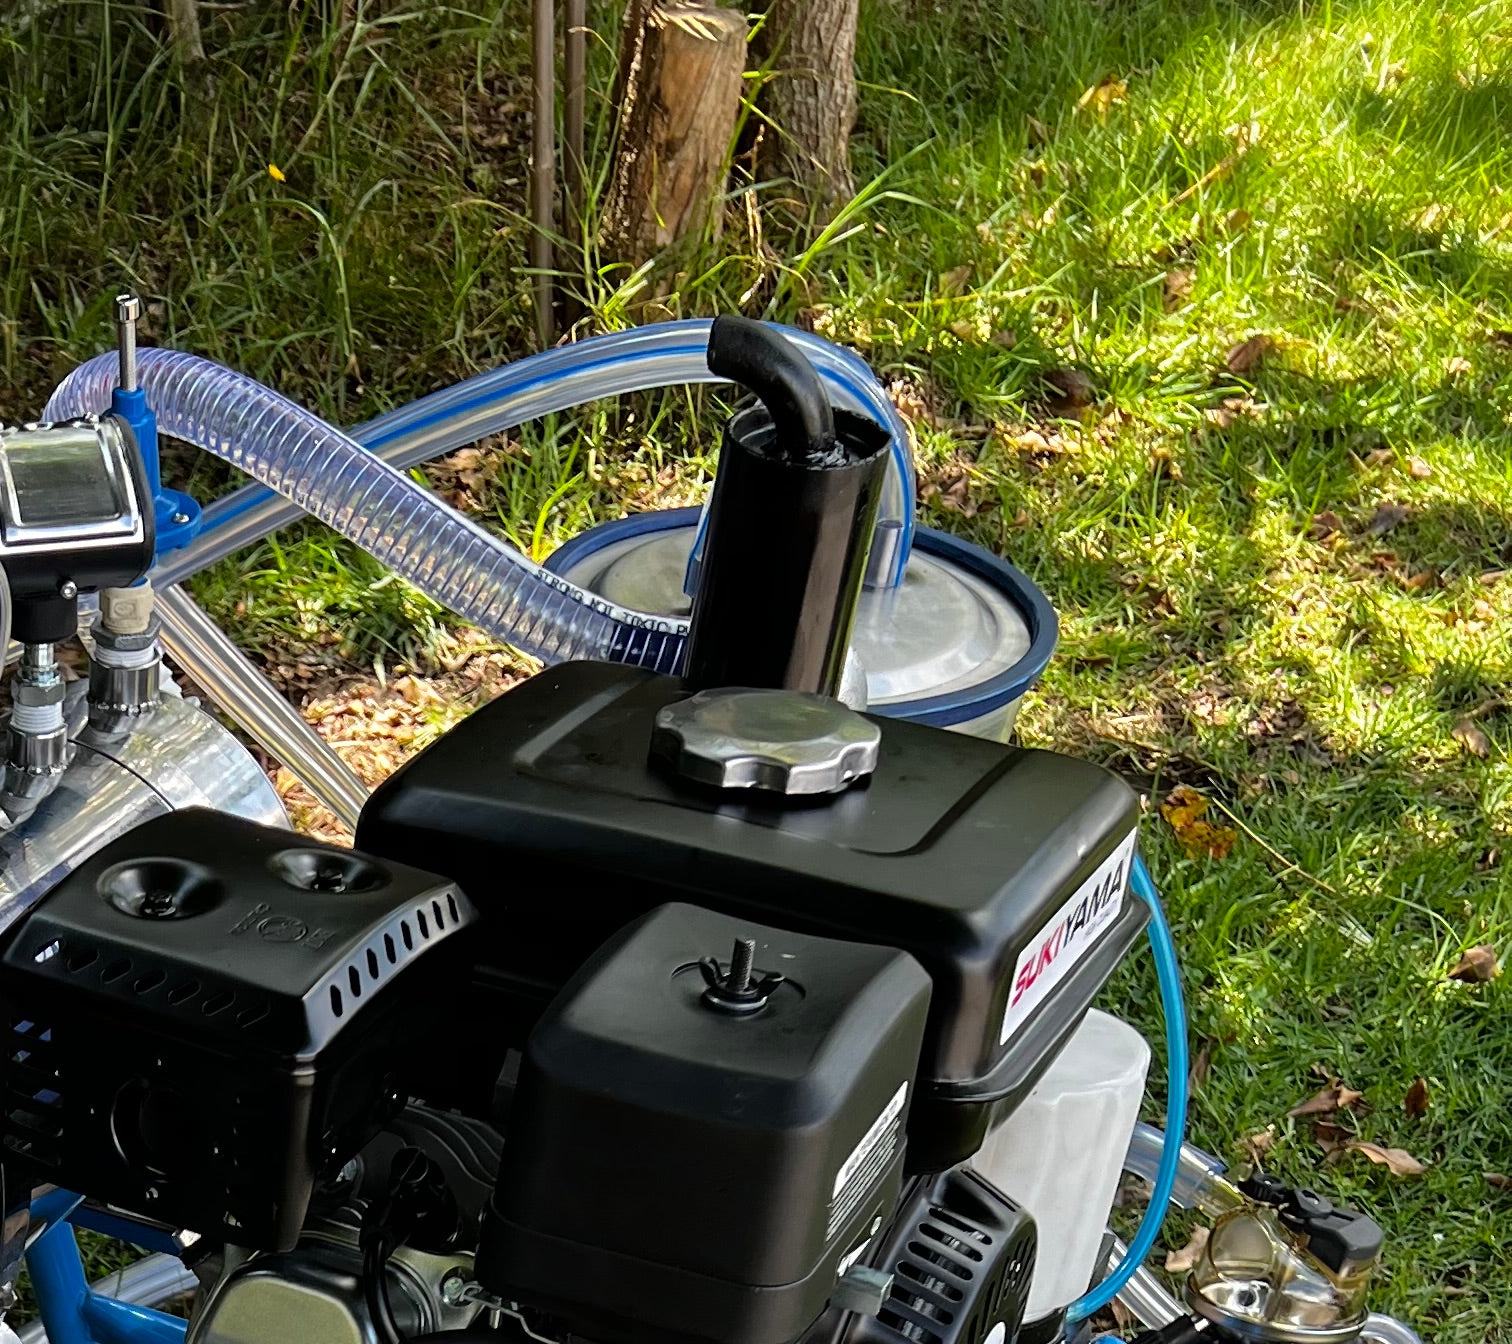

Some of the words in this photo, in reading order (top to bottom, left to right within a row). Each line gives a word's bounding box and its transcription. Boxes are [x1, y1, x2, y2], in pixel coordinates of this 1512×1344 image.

[538, 569, 584, 602] STRONG
[590, 597, 614, 617] NOT
[623, 611, 670, 633] TOXIC
[1011, 859, 1124, 1008] SUKIYAMA
